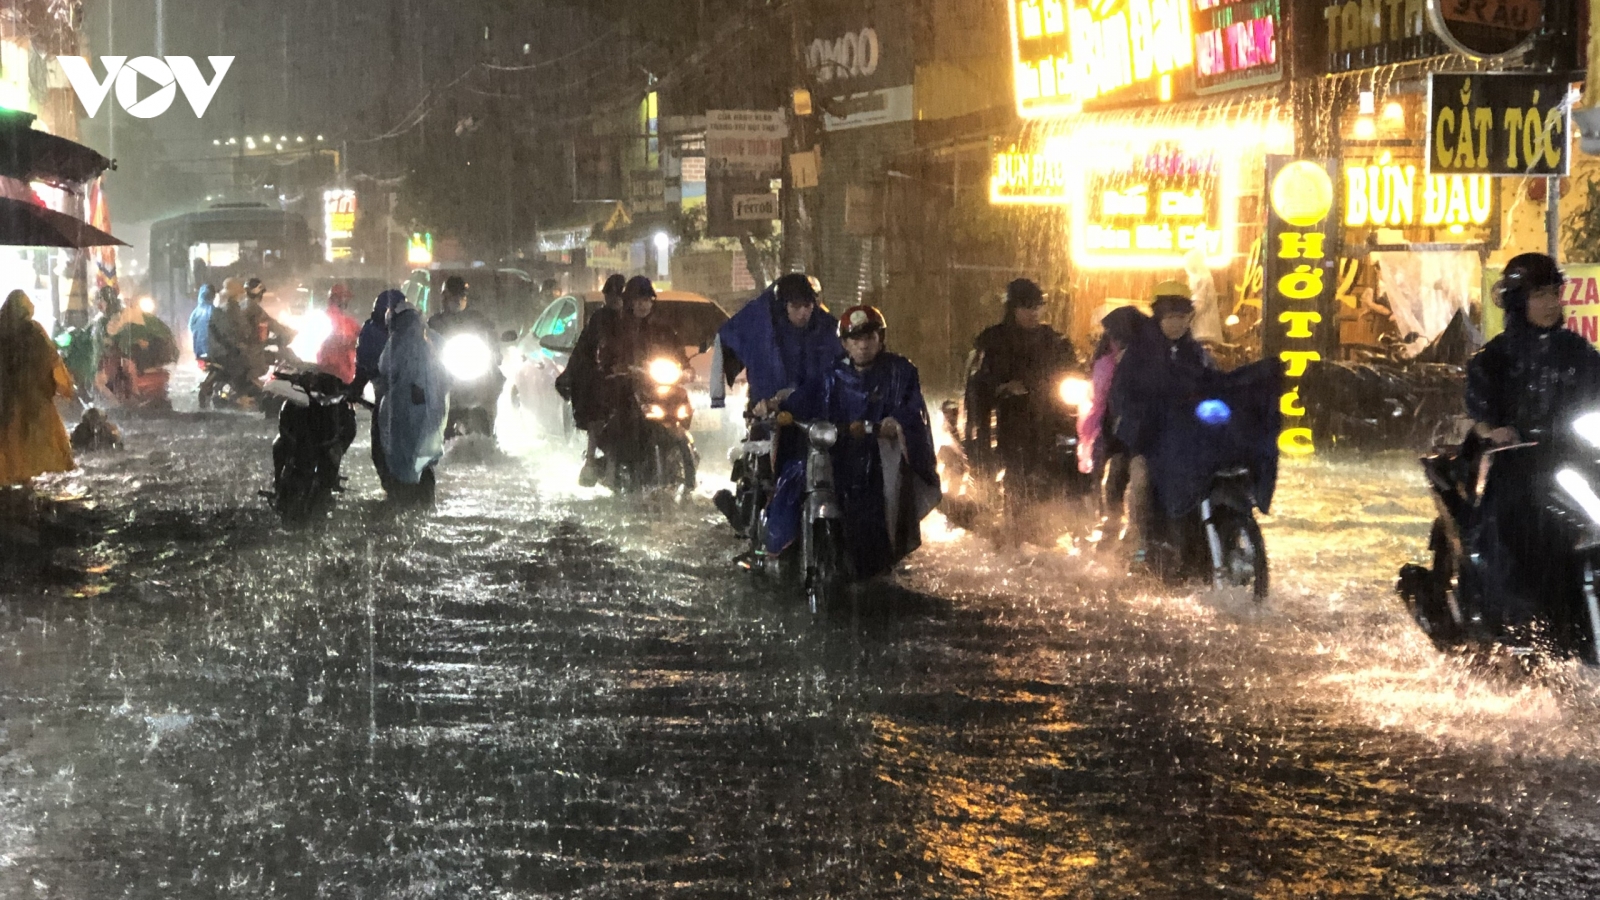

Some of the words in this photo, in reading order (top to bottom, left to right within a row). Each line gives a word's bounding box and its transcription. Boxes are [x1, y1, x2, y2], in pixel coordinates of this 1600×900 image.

[1436, 77, 1493, 168] CẮT
[1504, 89, 1563, 168] TÓC
[997, 143, 1030, 186] BÚN
[1344, 150, 1416, 227] BÚN
[1278, 232, 1326, 338] HỚT
[1559, 277, 1600, 307] ZZA
[1567, 310, 1599, 343] ÁN
